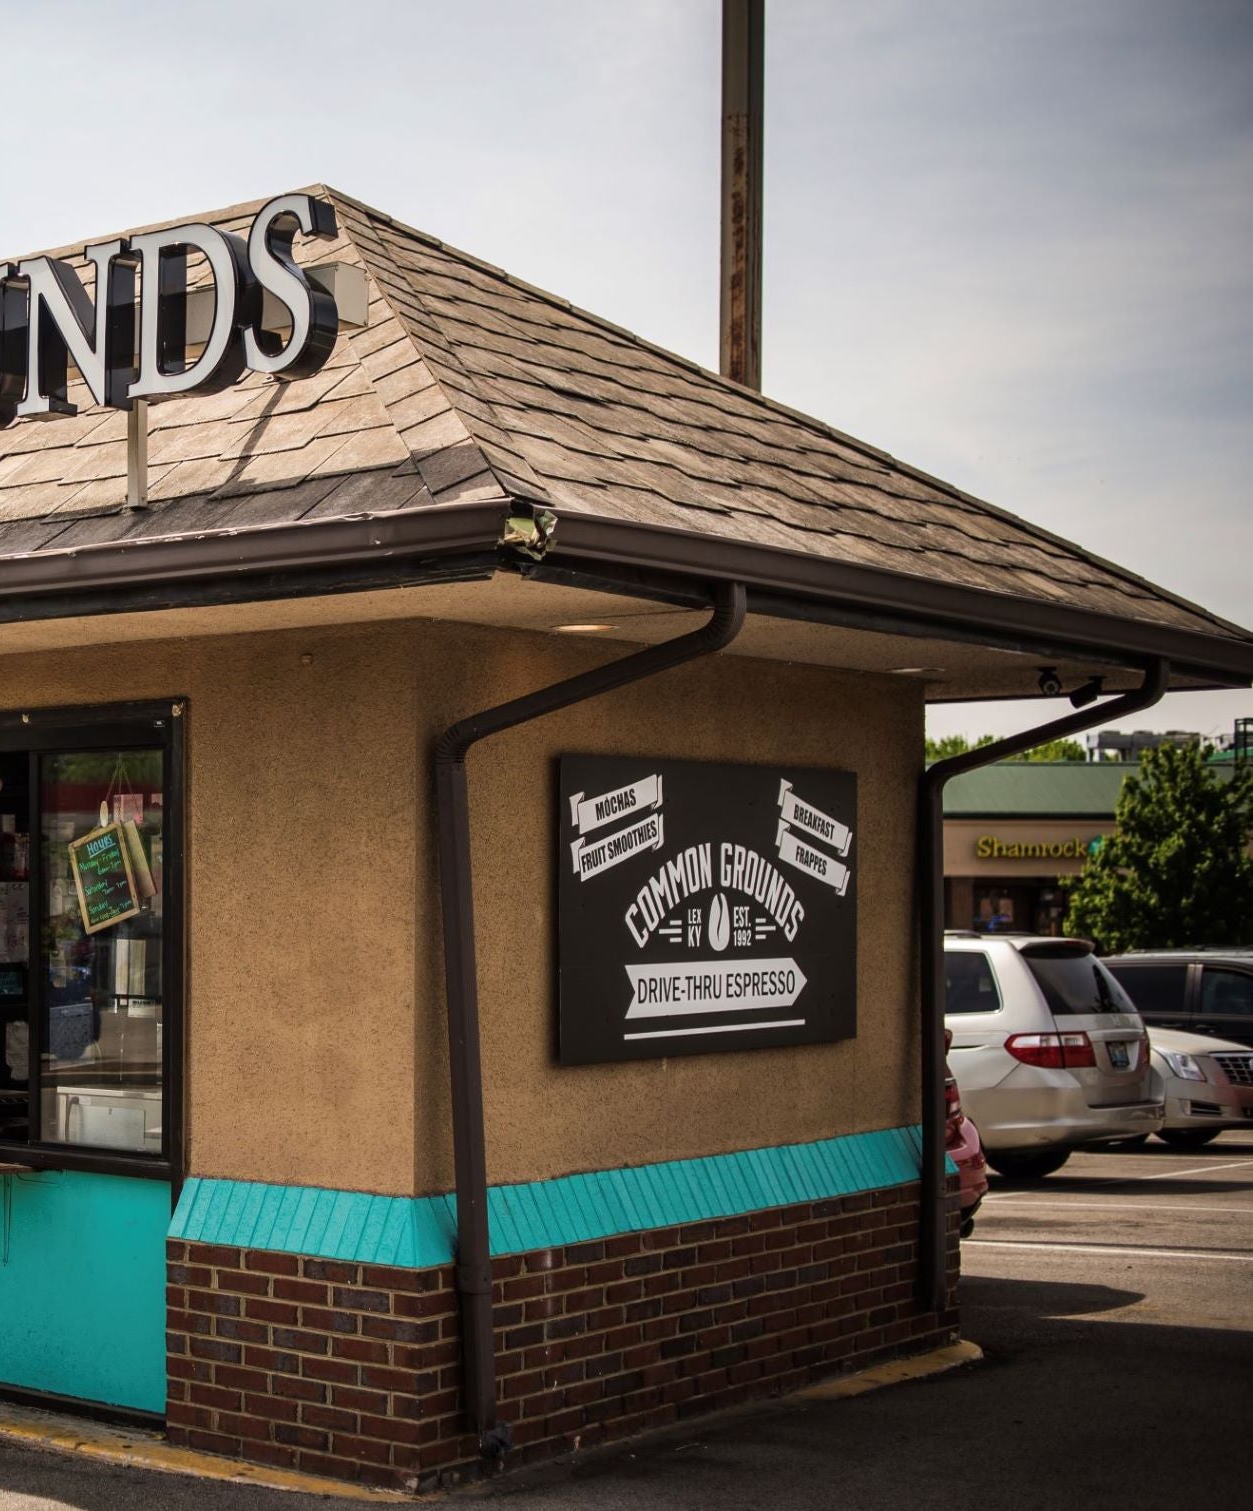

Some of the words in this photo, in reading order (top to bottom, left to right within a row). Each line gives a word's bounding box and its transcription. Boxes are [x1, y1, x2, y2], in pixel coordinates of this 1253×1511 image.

[595, 788, 637, 821] MOCHAS
[793, 803, 836, 841] BREAKFAST
[581, 842, 607, 873] FRUIT
[607, 819, 658, 860] SMOOTHIES
[794, 845, 828, 877] FRAPPES
[977, 835, 1087, 858] Shamrock
[625, 843, 713, 949] COMMON
[720, 842, 805, 943] GROUNDS
[688, 908, 702, 925] LEX
[733, 906, 751, 928] EST.
[688, 926, 702, 947] KY
[733, 929, 752, 947] 1992
[637, 974, 723, 1005] DRIVE-THRU
[725, 970, 796, 999] ESPRESSO
